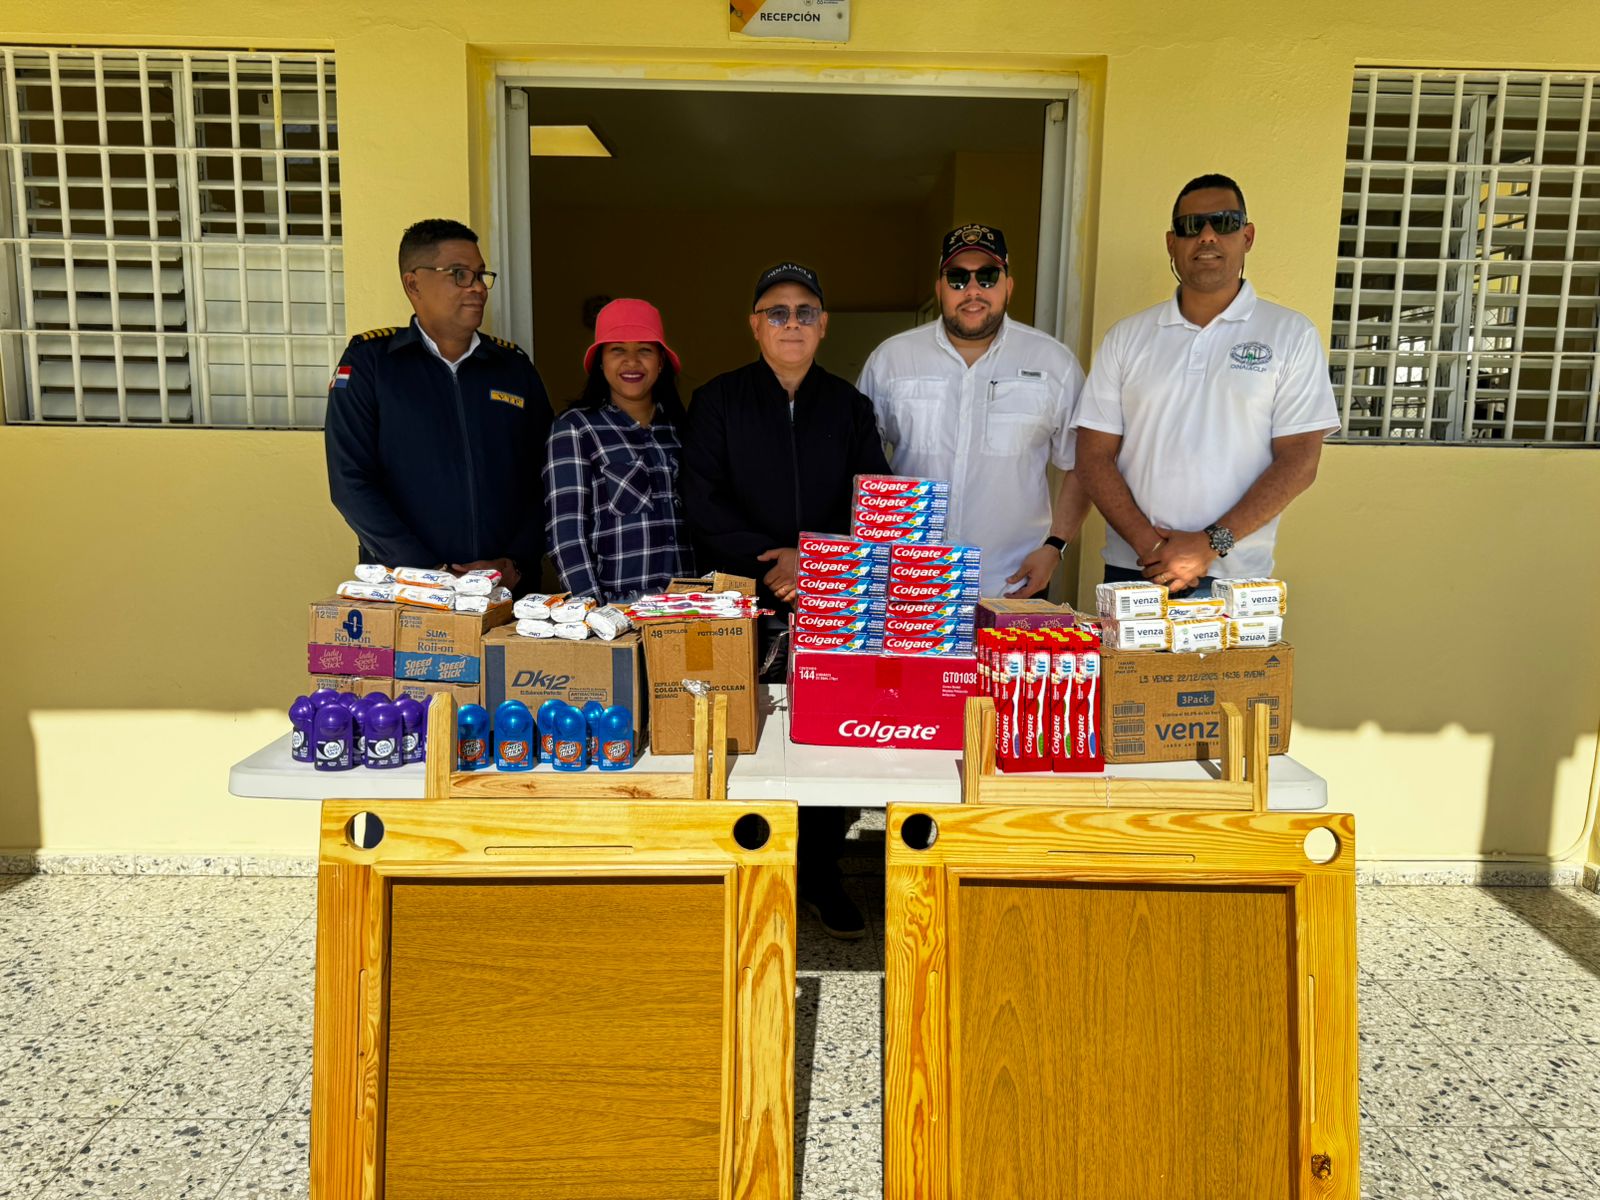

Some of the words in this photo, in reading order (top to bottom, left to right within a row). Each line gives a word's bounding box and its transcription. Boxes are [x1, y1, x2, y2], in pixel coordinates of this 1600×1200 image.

[760, 11, 821, 22] RECEPCIÓN
[862, 480, 909, 492] Colgate
[861, 496, 908, 508] Colgate
[858, 512, 905, 524] Colgate
[857, 527, 903, 539] Colgate
[803, 541, 851, 554] Colgate
[894, 547, 943, 560] Colgate
[802, 560, 850, 573] Colgate
[893, 566, 941, 579] Colgate
[800, 578, 848, 591] Colgate
[893, 585, 941, 597] Colgate
[801, 597, 848, 609] Colgate
[1133, 597, 1159, 605] venza
[1251, 595, 1278, 603] venza
[888, 602, 936, 614] Colgate
[798, 616, 846, 628] Colgate
[887, 620, 935, 632] Colgate
[426, 630, 447, 638] SLIM
[650, 630, 663, 639] 48
[797, 634, 845, 646] Colgate
[1193, 632, 1219, 640] venza
[417, 642, 454, 653] Roll-on
[886, 638, 934, 650] Colgate
[799, 670, 815, 680] 144
[1152, 675, 1174, 683] VENCE
[1181, 695, 1209, 704] 3Pack
[838, 720, 937, 743] Colgate
[1000, 714, 1010, 755] Colgate
[1025, 714, 1034, 754] Colgate
[1051, 714, 1061, 755] Colgate
[1077, 714, 1085, 754] Colgate
[1155, 721, 1220, 740] venz
